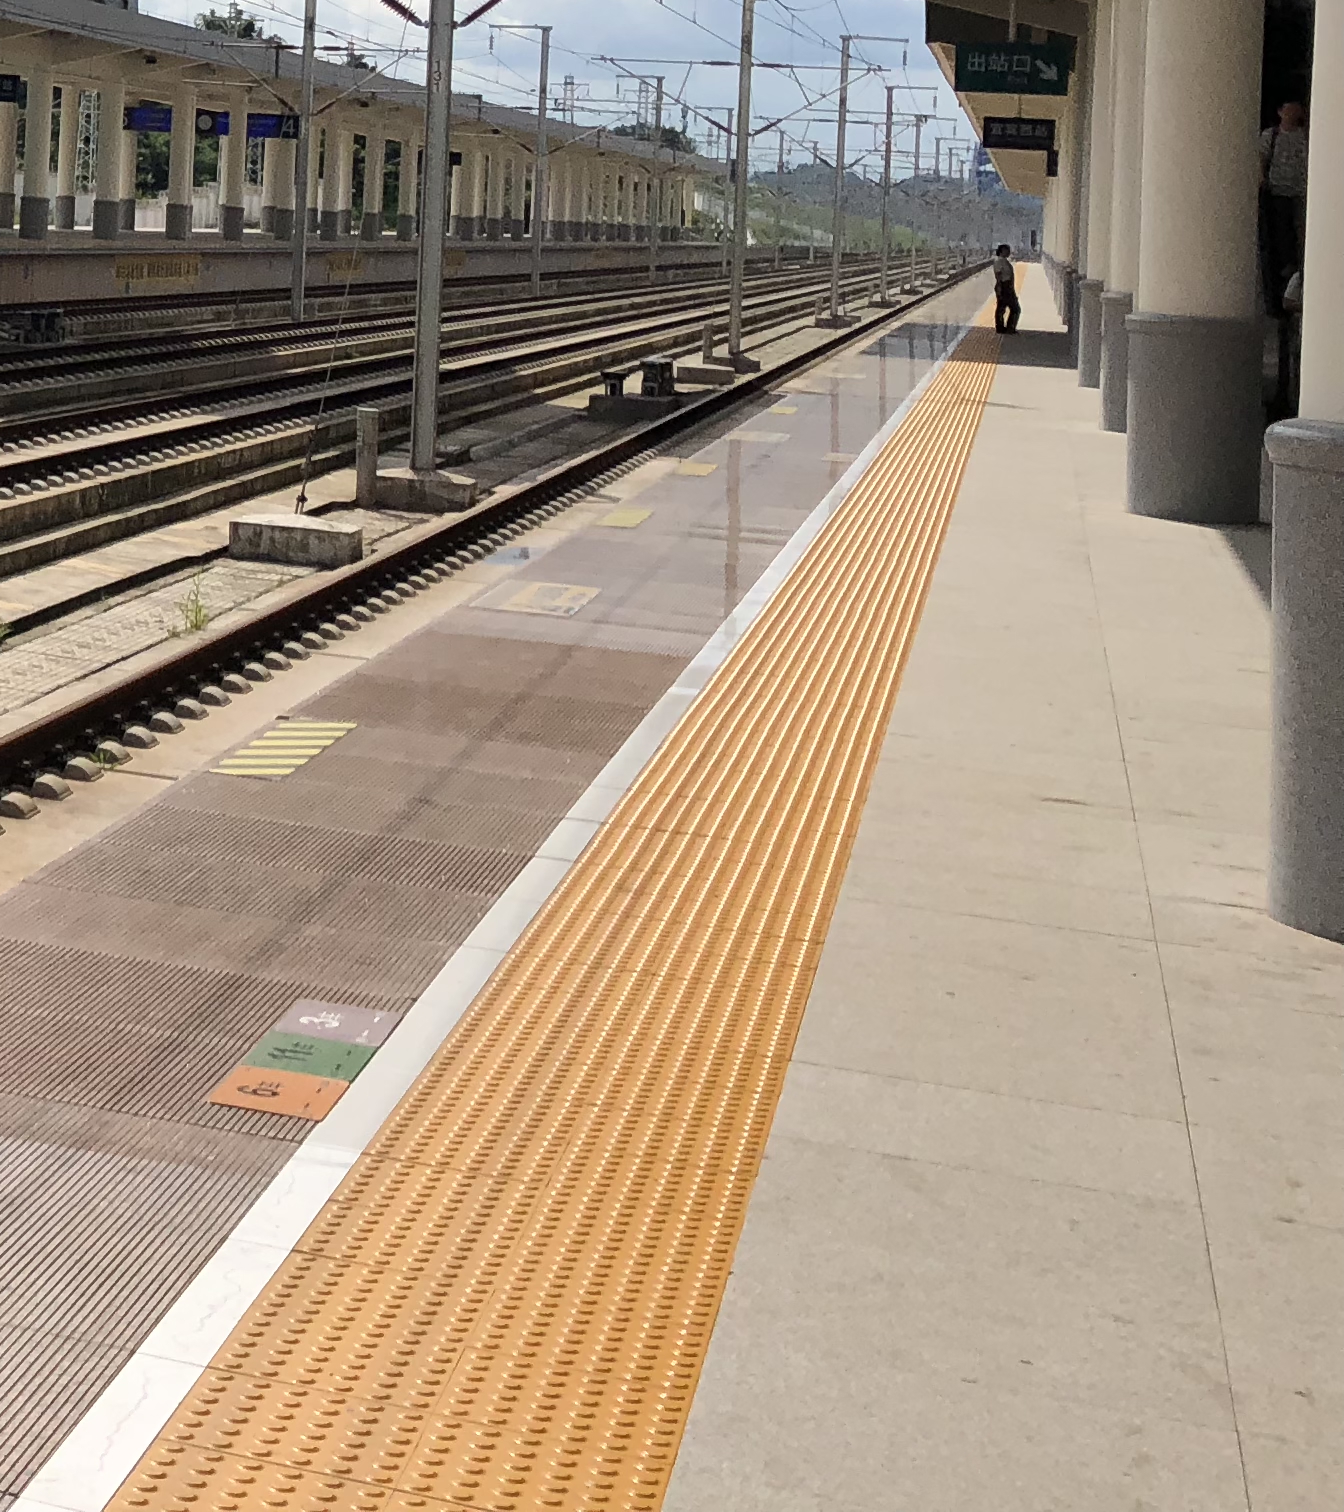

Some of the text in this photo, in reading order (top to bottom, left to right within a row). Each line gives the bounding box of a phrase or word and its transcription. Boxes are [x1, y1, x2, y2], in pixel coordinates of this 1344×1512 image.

[433, 59, 442, 93] 131
[967, 51, 1031, 73] 出站口
